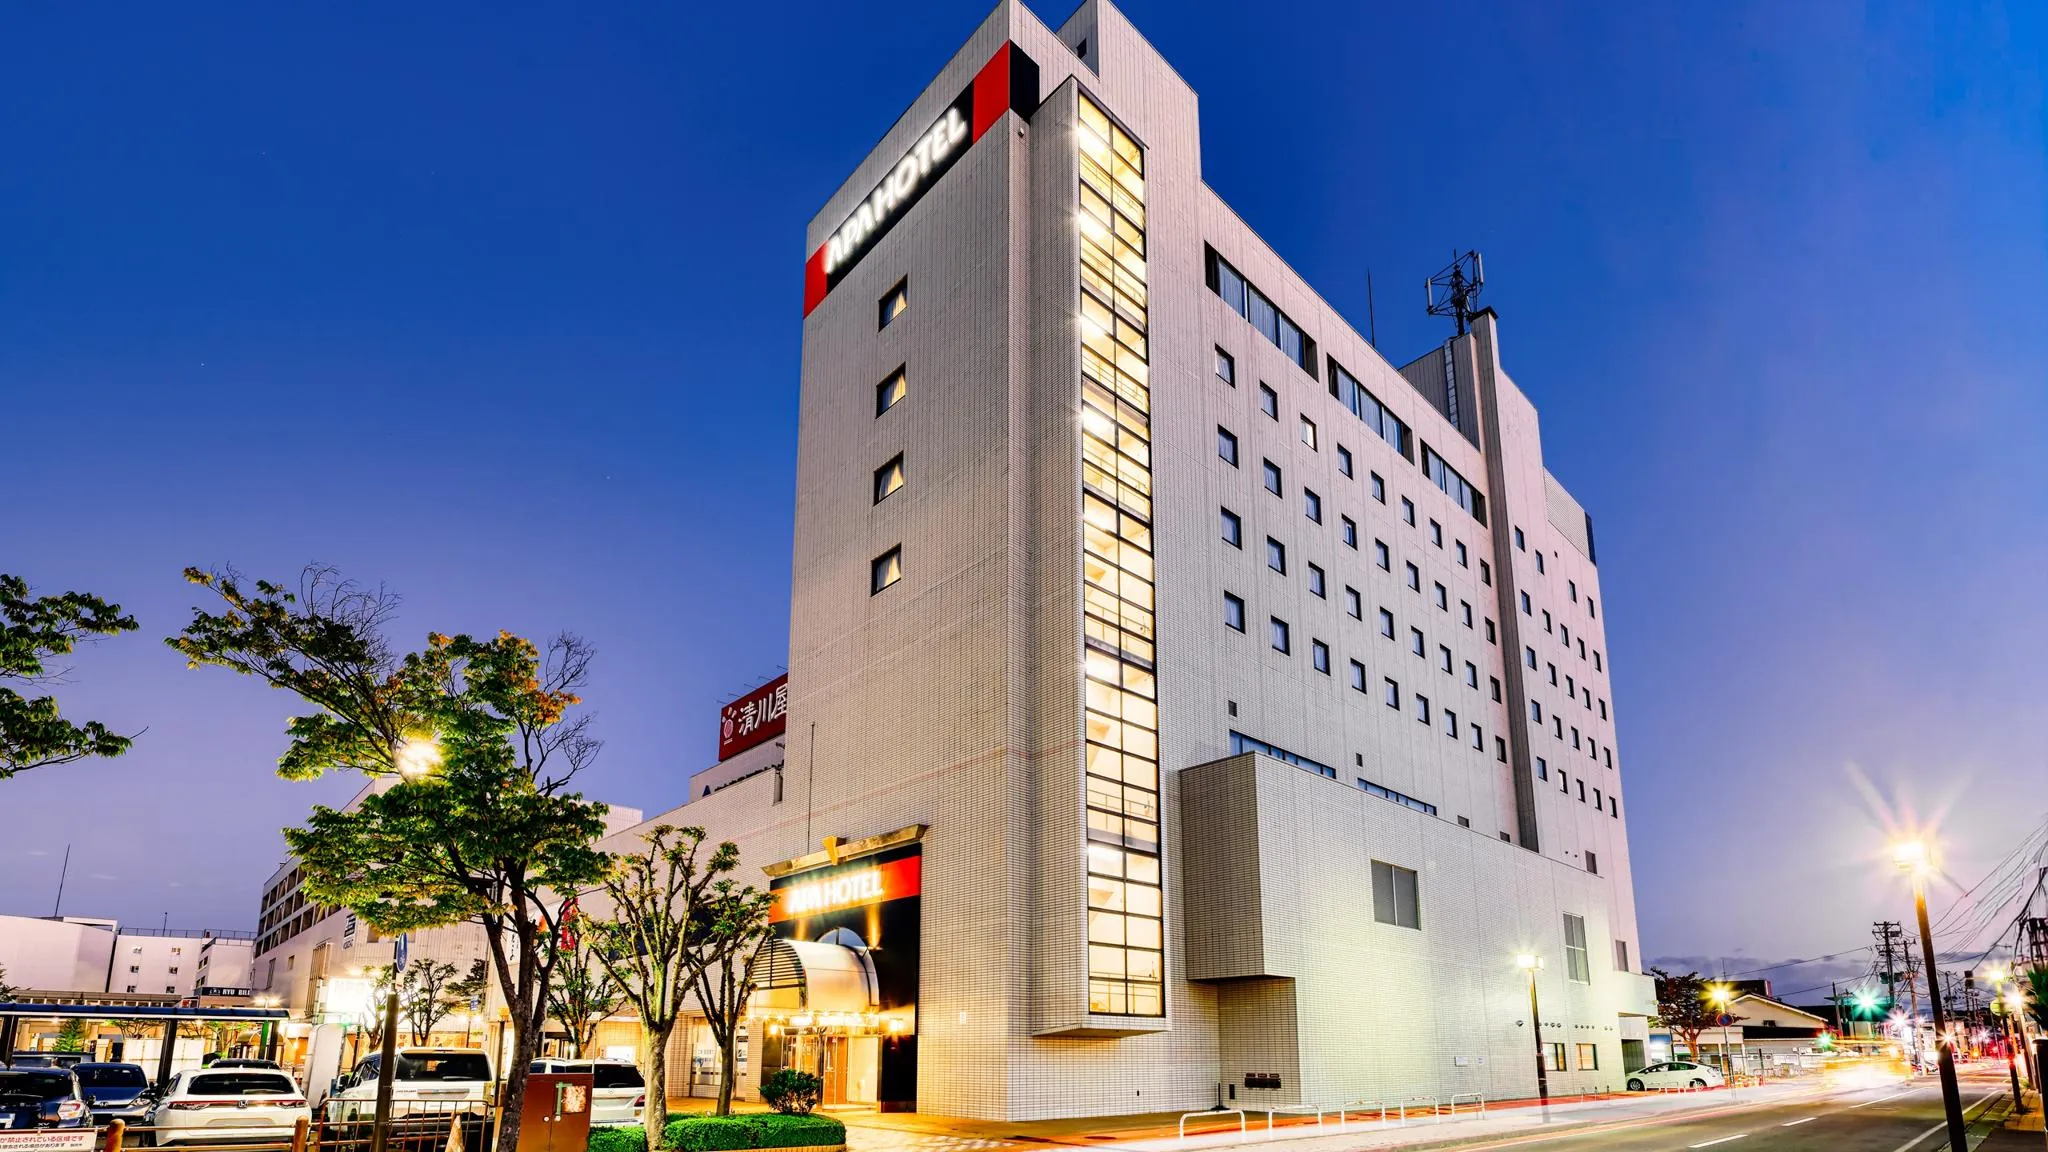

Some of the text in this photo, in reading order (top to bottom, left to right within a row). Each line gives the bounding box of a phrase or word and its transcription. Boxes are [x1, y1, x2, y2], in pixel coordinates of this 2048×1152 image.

[823, 107, 967, 274] APA HOTEL
[738, 683, 787, 736] 清川屋
[824, 870, 884, 904] HOTEL
